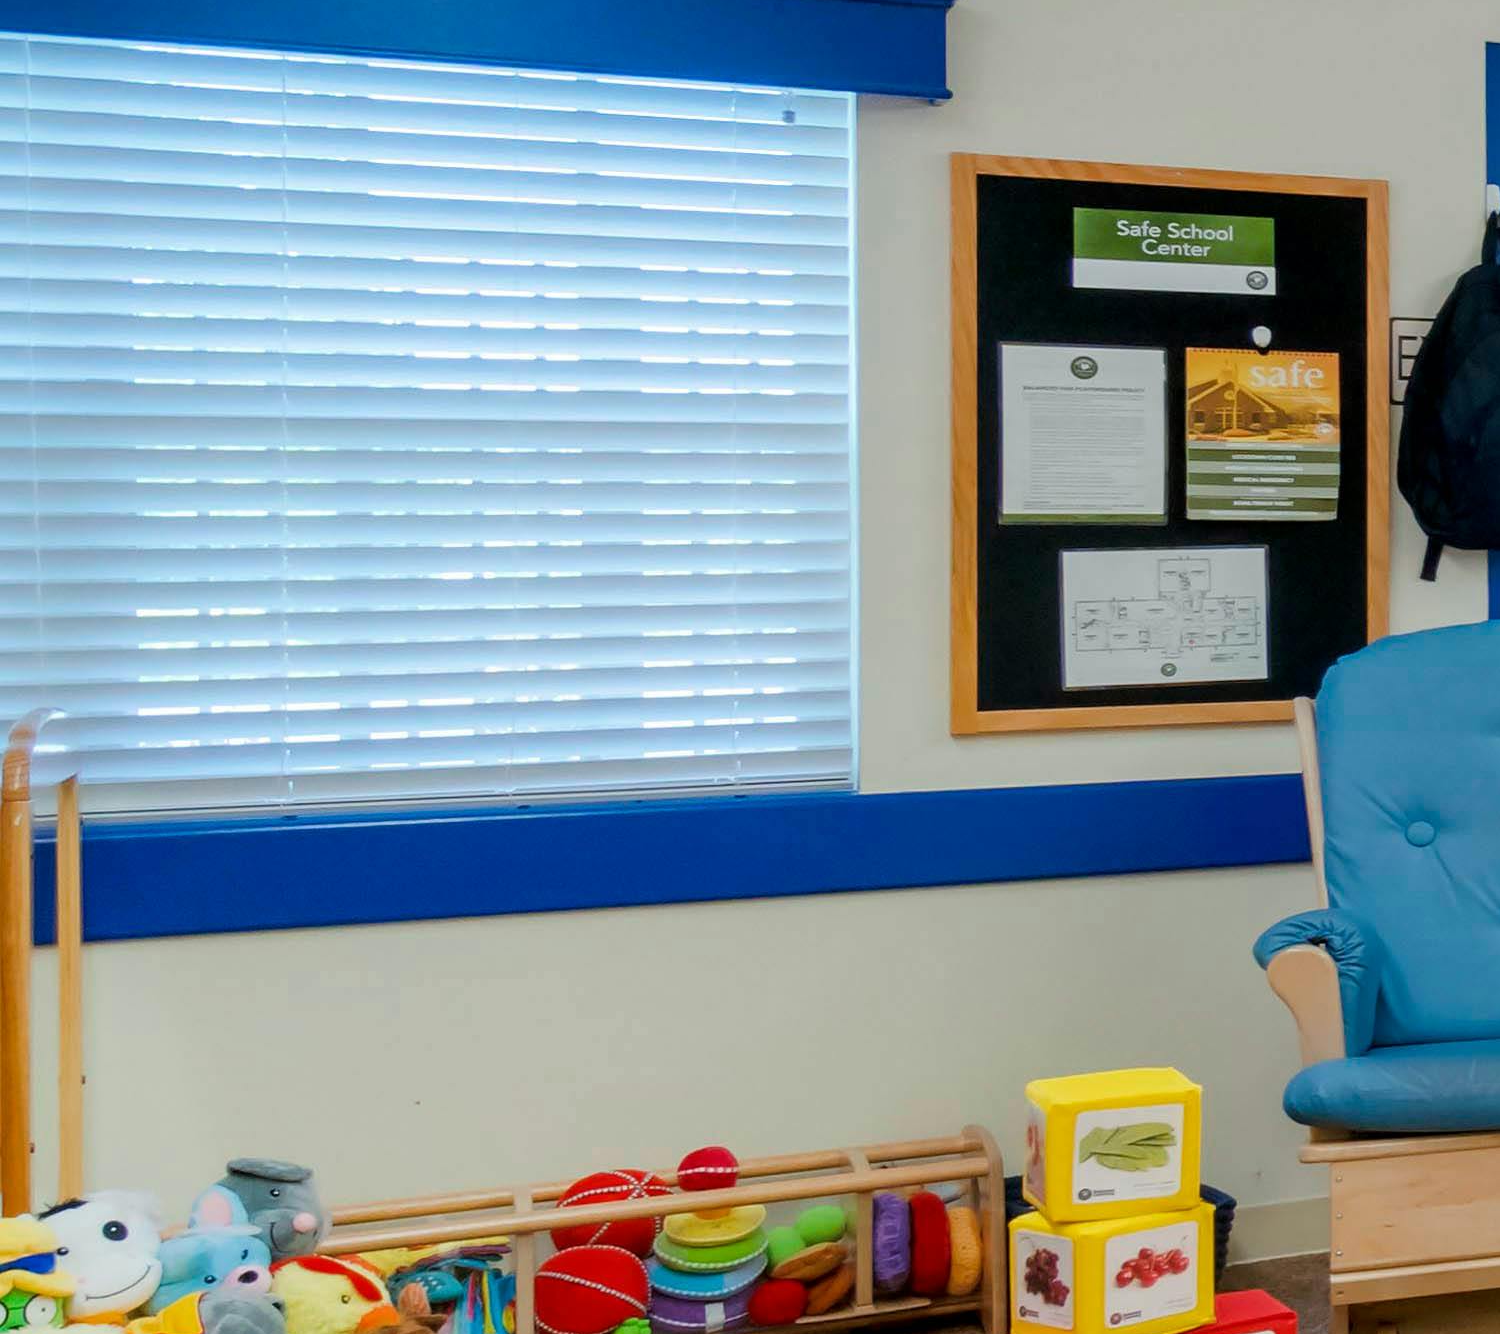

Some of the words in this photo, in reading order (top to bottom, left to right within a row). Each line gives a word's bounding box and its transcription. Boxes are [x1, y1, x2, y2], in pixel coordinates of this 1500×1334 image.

[1116, 219, 1162, 238] Safe
[1167, 223, 1234, 242] School
[1142, 238, 1212, 257] Center
[1250, 359, 1325, 389] safe
